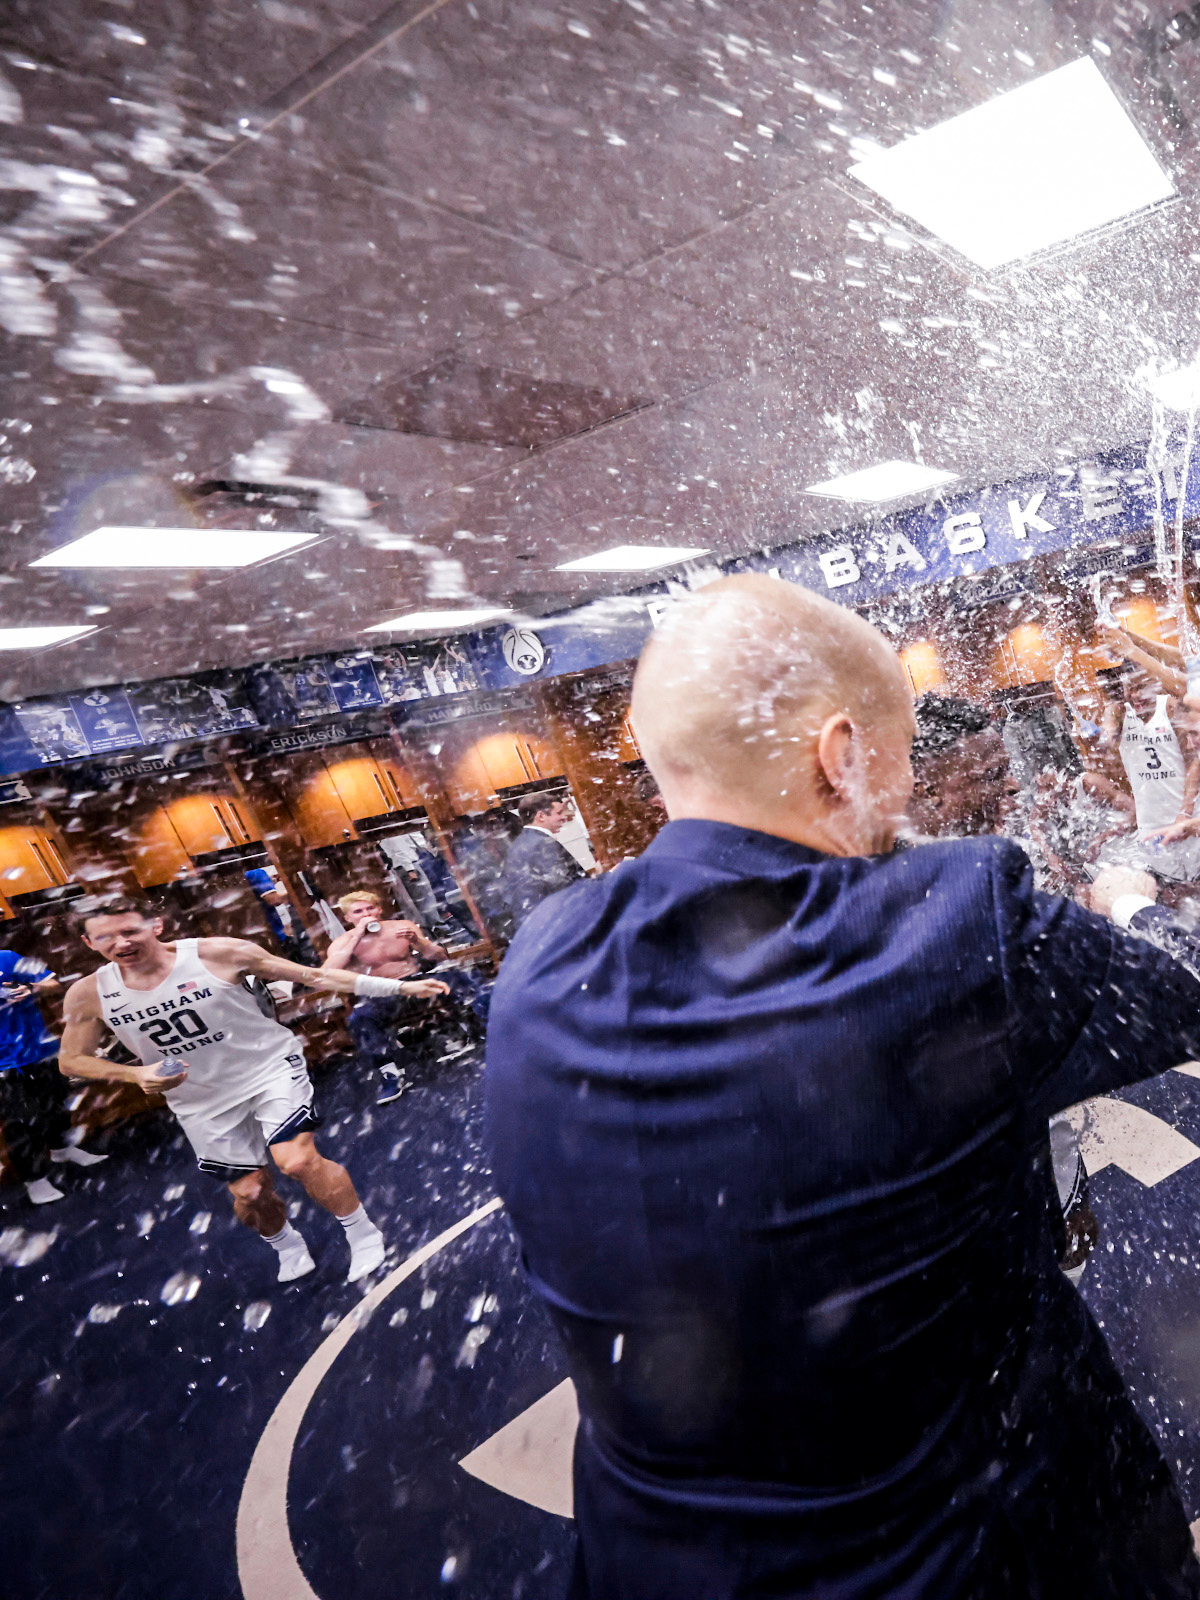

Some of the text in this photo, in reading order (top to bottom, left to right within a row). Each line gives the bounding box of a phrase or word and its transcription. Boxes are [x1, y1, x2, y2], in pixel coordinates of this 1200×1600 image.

[270, 727, 348, 749] ERICKSON
[1144, 747, 1162, 770] 3
[100, 760, 177, 781] JOHNSON
[1138, 770, 1177, 780] YOUNG
[109, 987, 213, 1026] BRIGHAM
[138, 1008, 209, 1047] 20
[158, 1031, 225, 1057] YOUNG
